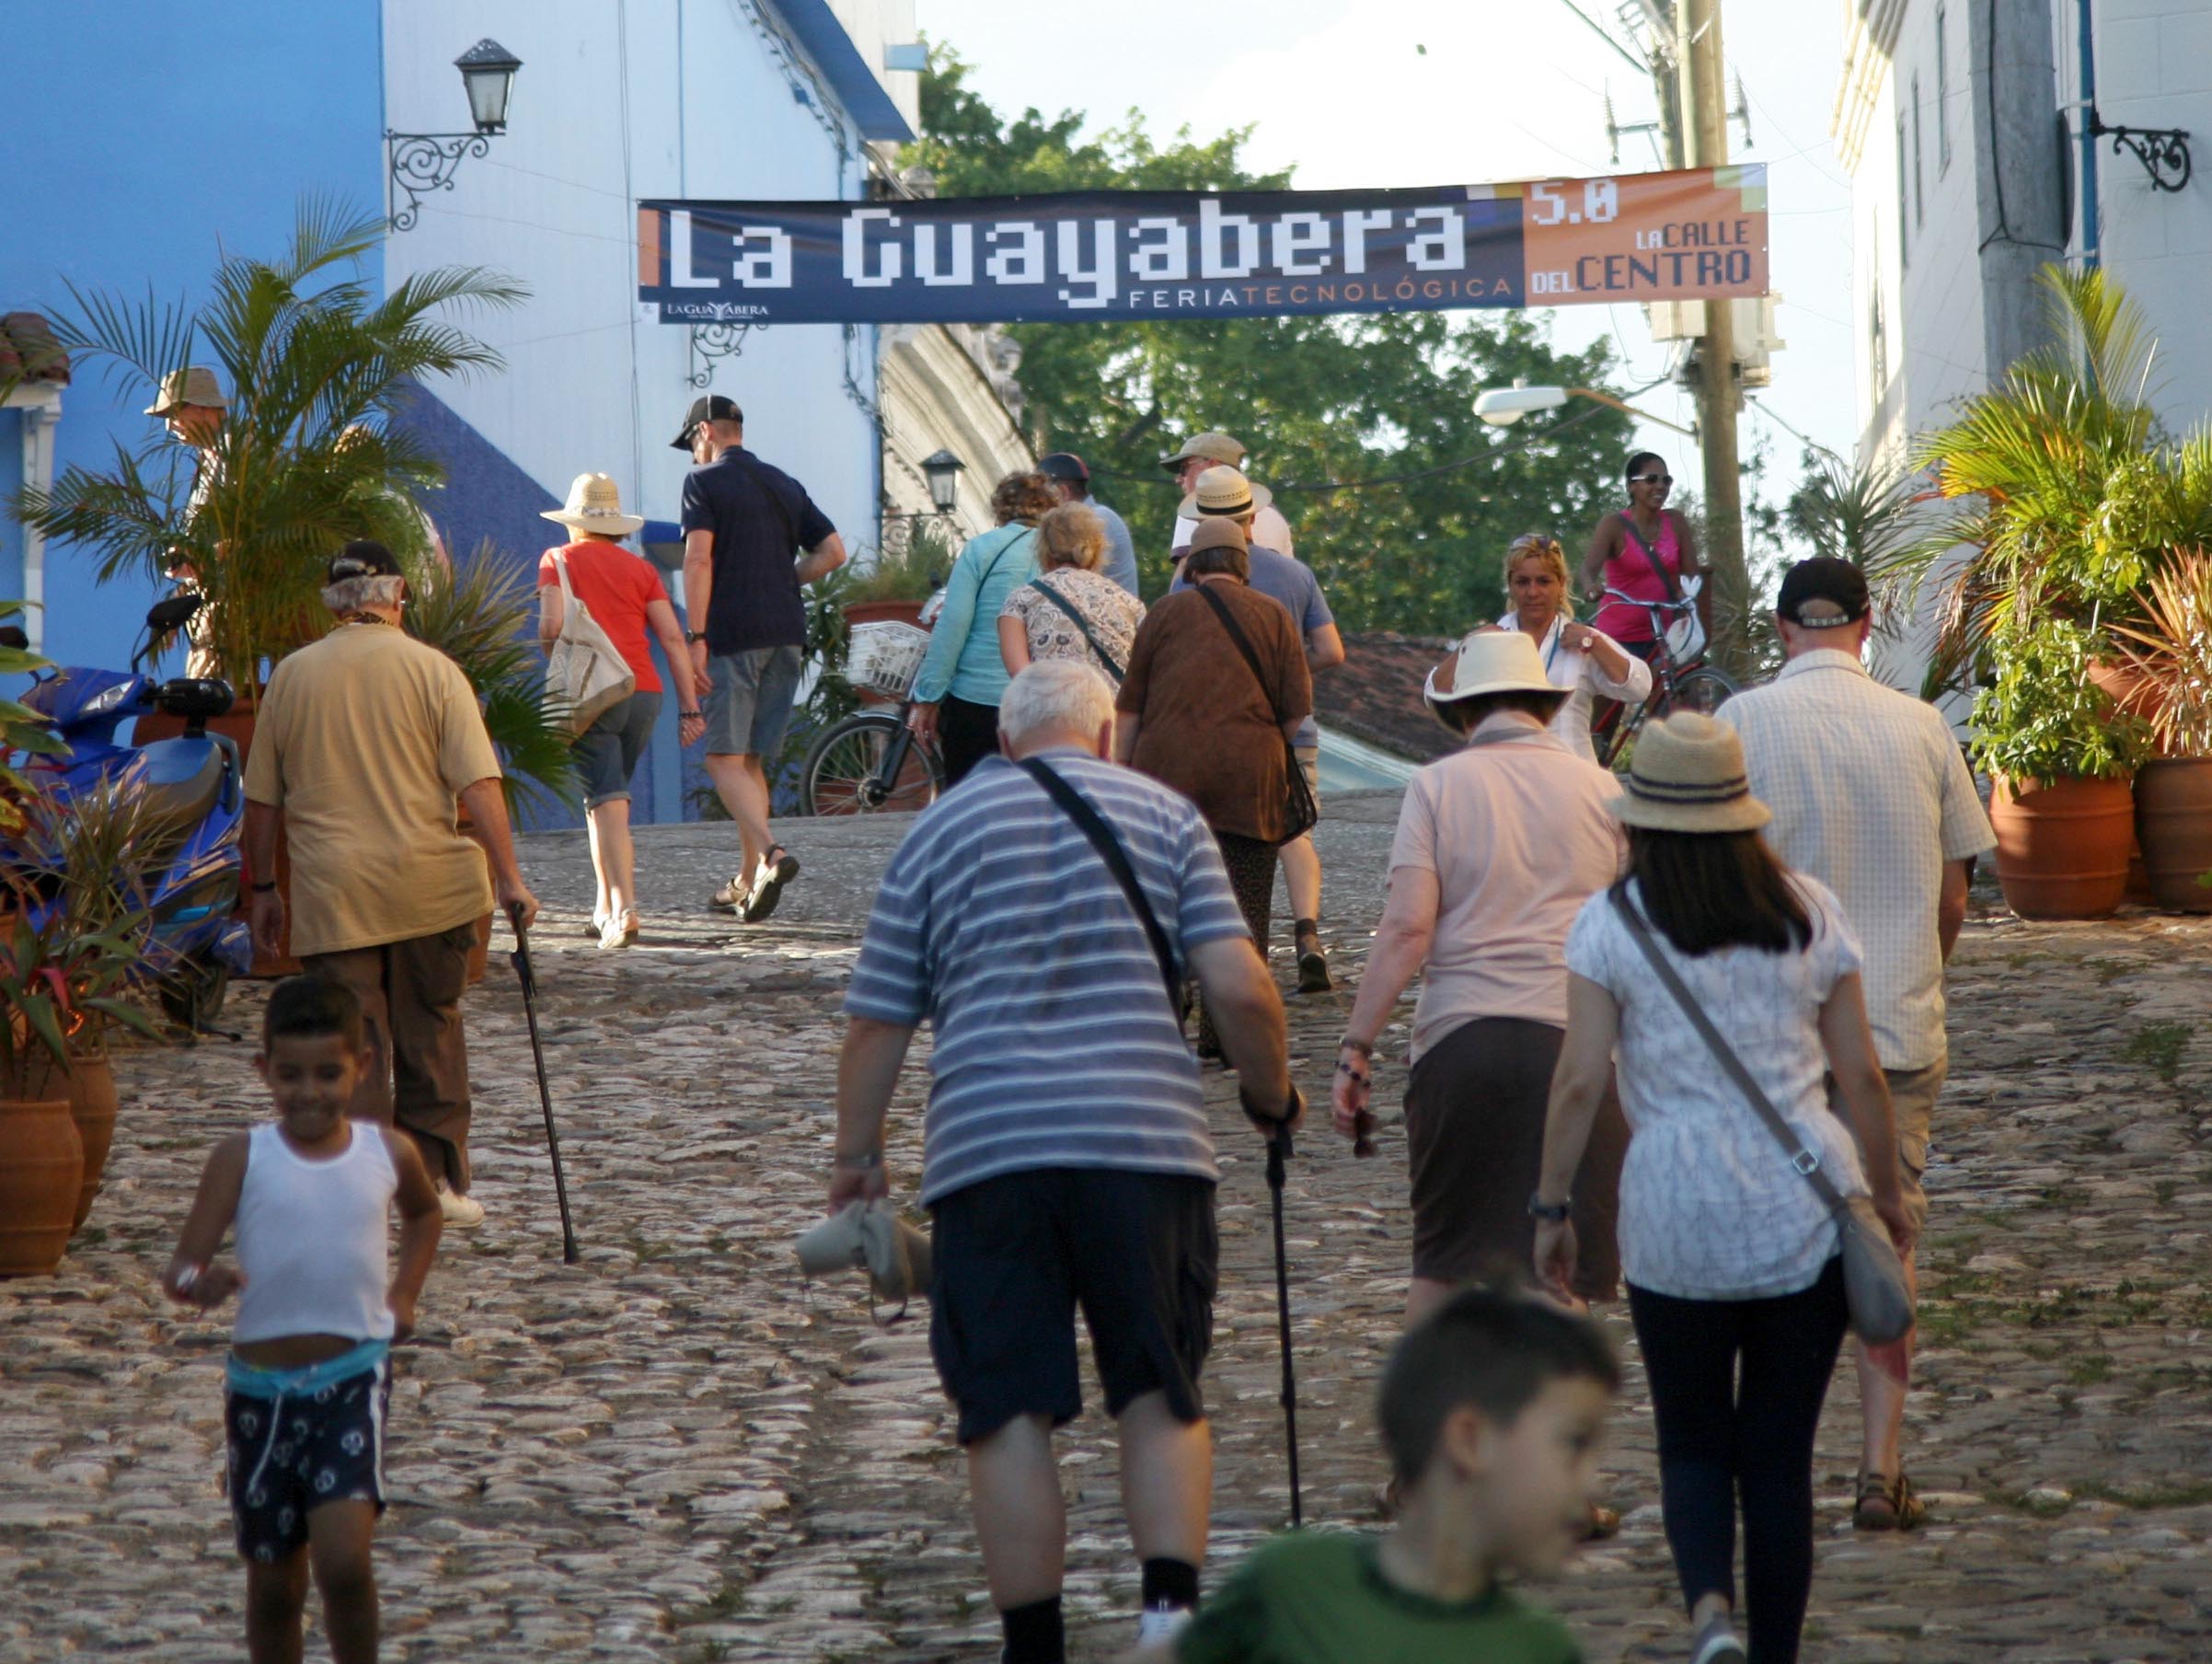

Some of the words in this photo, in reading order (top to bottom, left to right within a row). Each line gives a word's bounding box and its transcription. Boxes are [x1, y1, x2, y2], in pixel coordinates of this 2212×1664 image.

[1531, 179, 1619, 225] 5.0
[670, 209, 792, 289] La
[842, 199, 1465, 308] Guayabera
